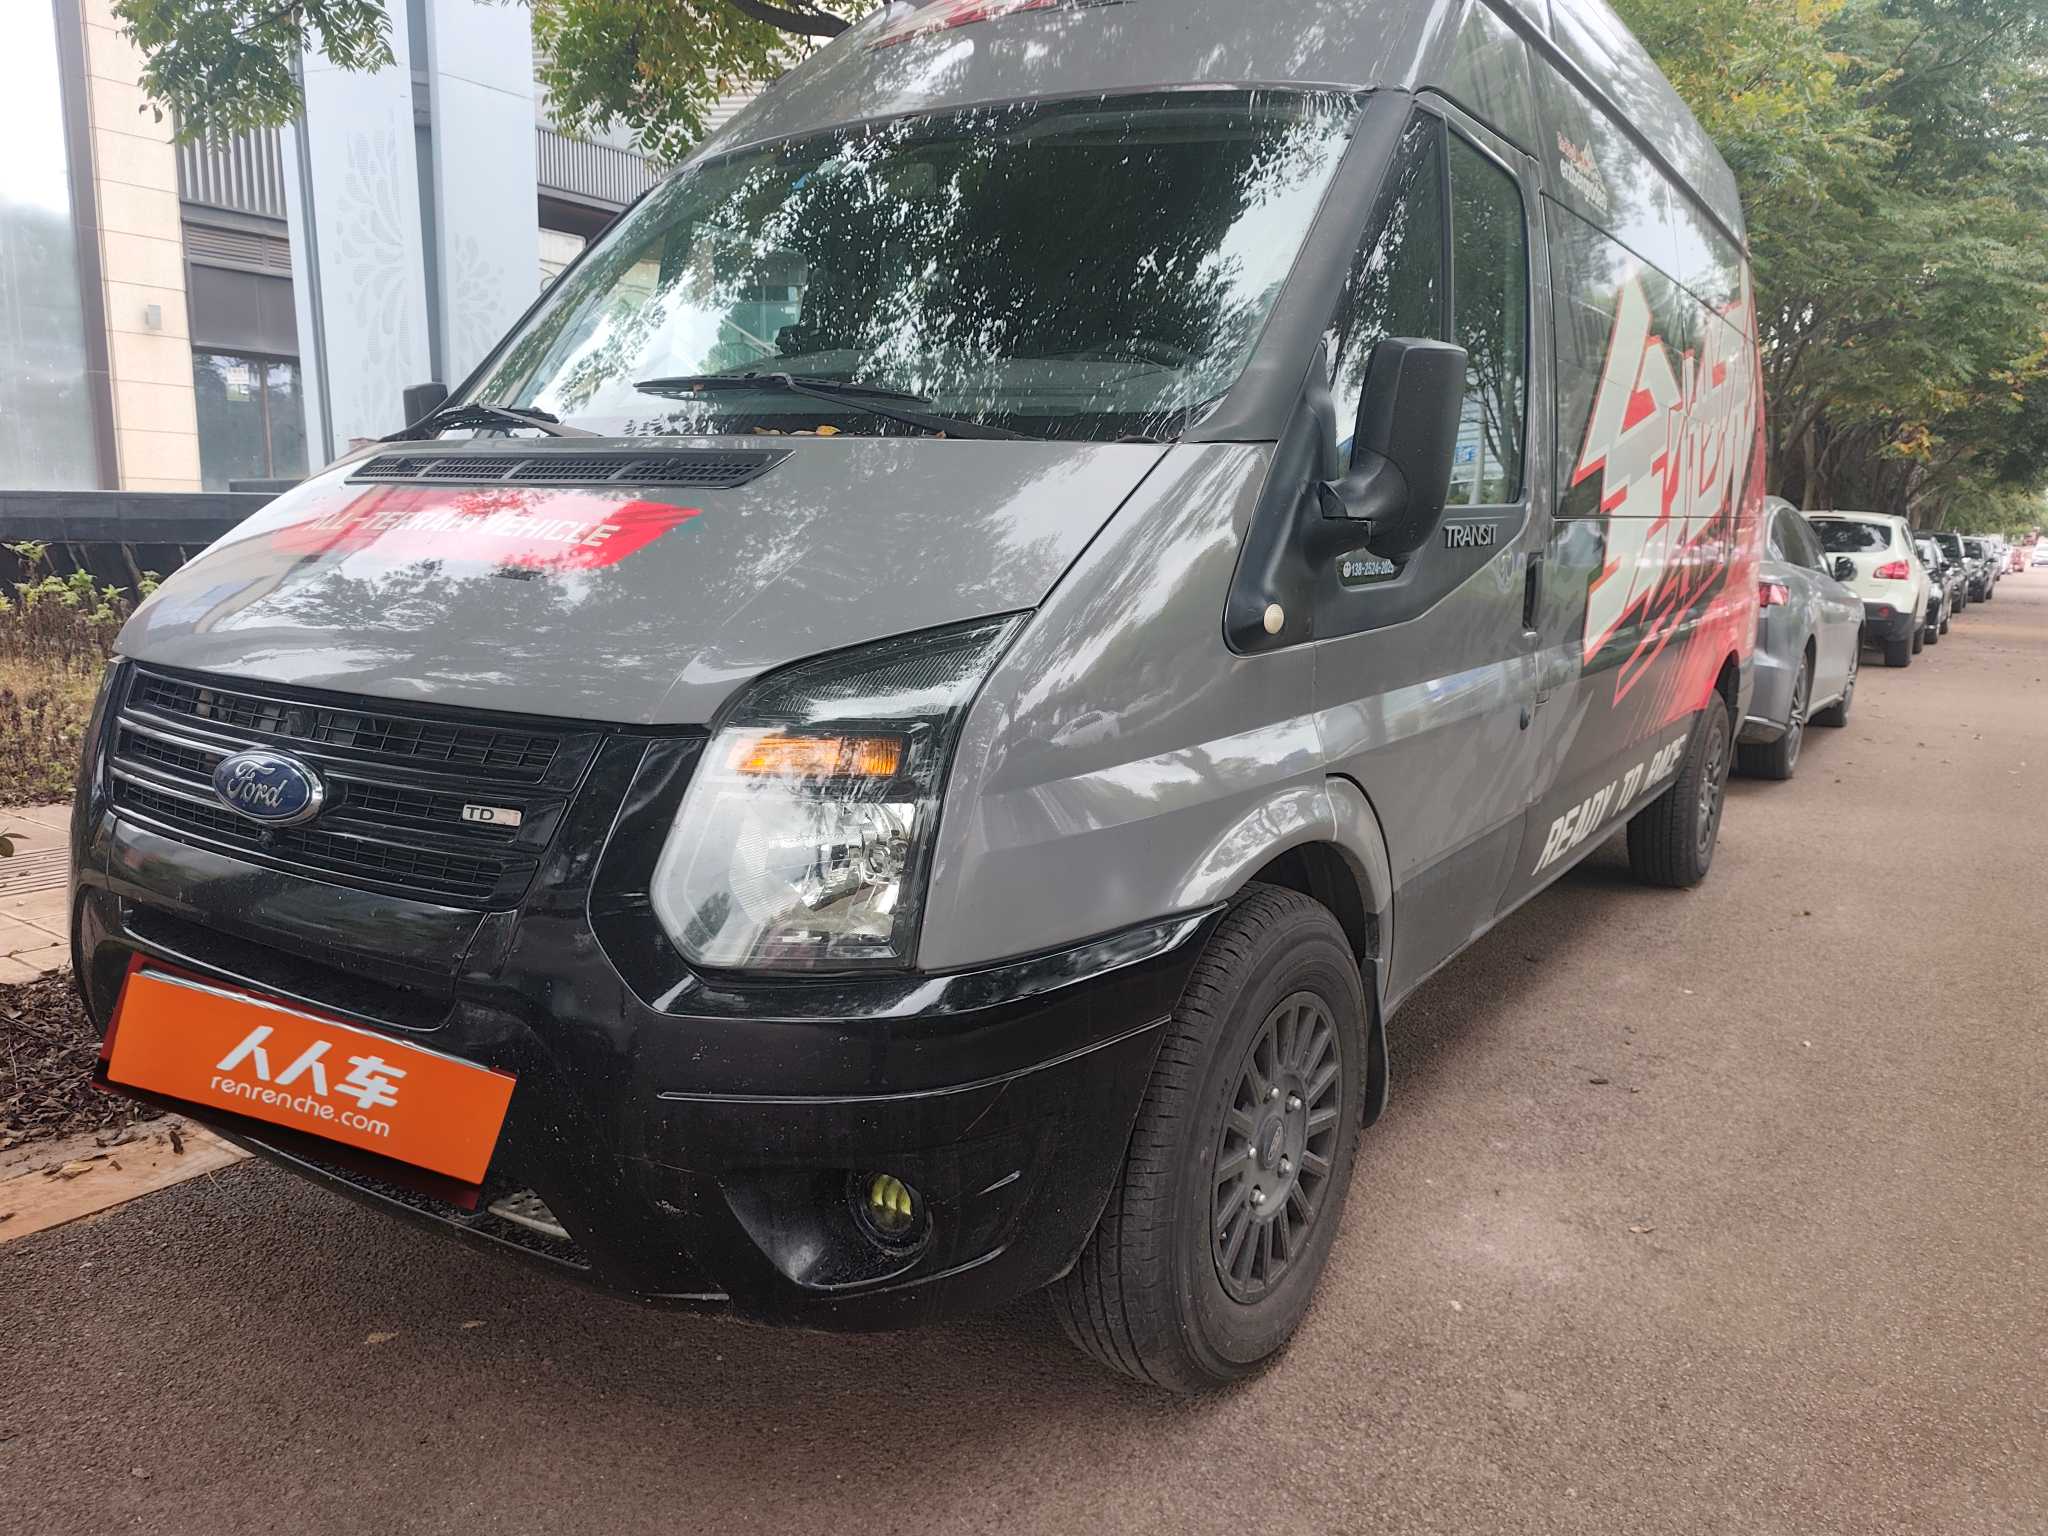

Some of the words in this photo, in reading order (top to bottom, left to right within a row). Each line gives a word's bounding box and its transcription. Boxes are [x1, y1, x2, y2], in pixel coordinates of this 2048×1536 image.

[482, 511, 622, 548] VEHICLE
[1443, 523, 1499, 549] TRANSIT
[226, 759, 289, 809] Ford
[1530, 780, 1618, 877] READY
[1611, 762, 1645, 818] TO
[215, 1025, 408, 1110] 人人车
[210, 1075, 390, 1138] renrenche.com
